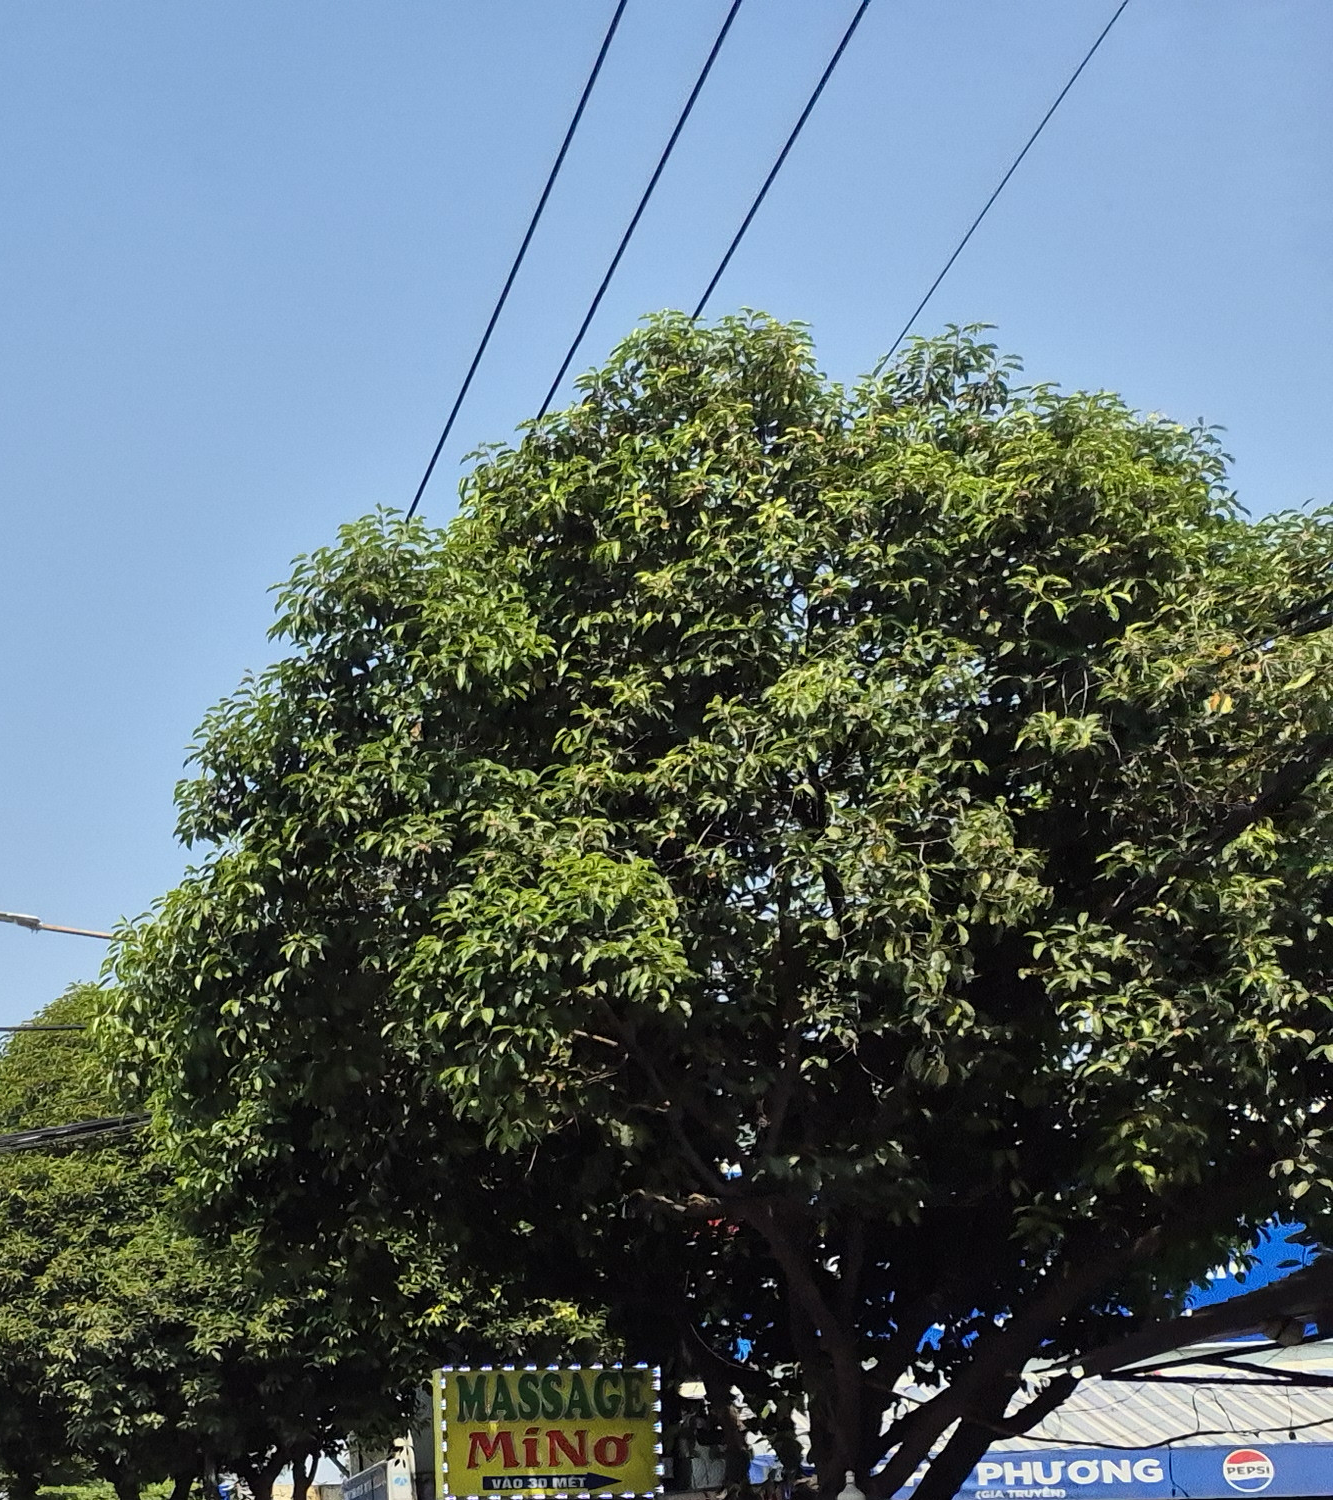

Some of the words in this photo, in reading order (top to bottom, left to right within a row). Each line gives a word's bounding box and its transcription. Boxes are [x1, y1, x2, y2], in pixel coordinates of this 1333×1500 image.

[455, 1371, 648, 1423] MASSAGE
[976, 1459, 1165, 1487] PHƯƠNG
[1226, 1465, 1271, 1476] PEPSI
[527, 1478, 548, 1490] 30
